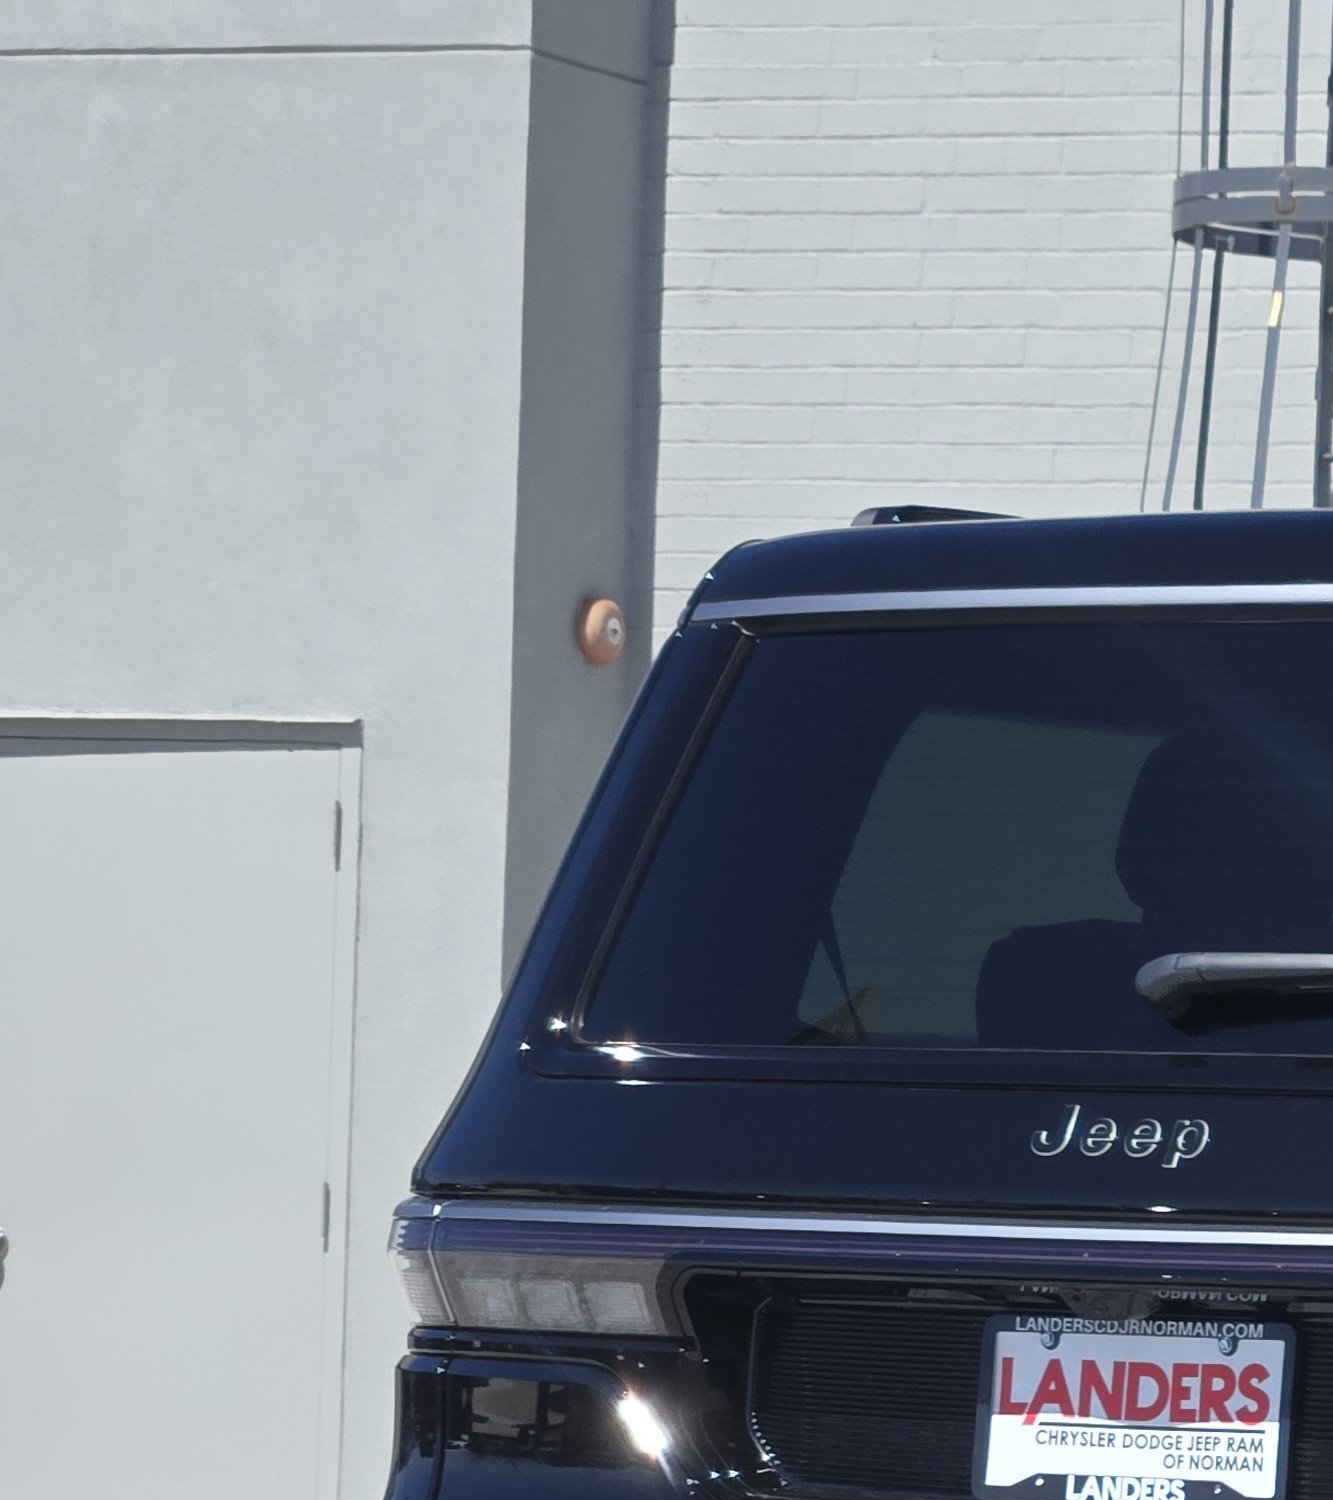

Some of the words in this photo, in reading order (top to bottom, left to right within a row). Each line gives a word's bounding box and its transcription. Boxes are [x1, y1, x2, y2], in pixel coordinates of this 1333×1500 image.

[1030, 1104, 1211, 1169] Jeep
[1015, 1316, 1264, 1340] LANDERSCDJRNORMAN.COM
[999, 1356, 1271, 1427] LANDERS
[1035, 1429, 1116, 1449] CHRYSLER
[1122, 1433, 1183, 1452] DODGE
[1187, 1436, 1221, 1452] JEEP
[1226, 1437, 1264, 1454] RAM
[1163, 1453, 1184, 1470] OF
[1188, 1454, 1264, 1473] NORMAN
